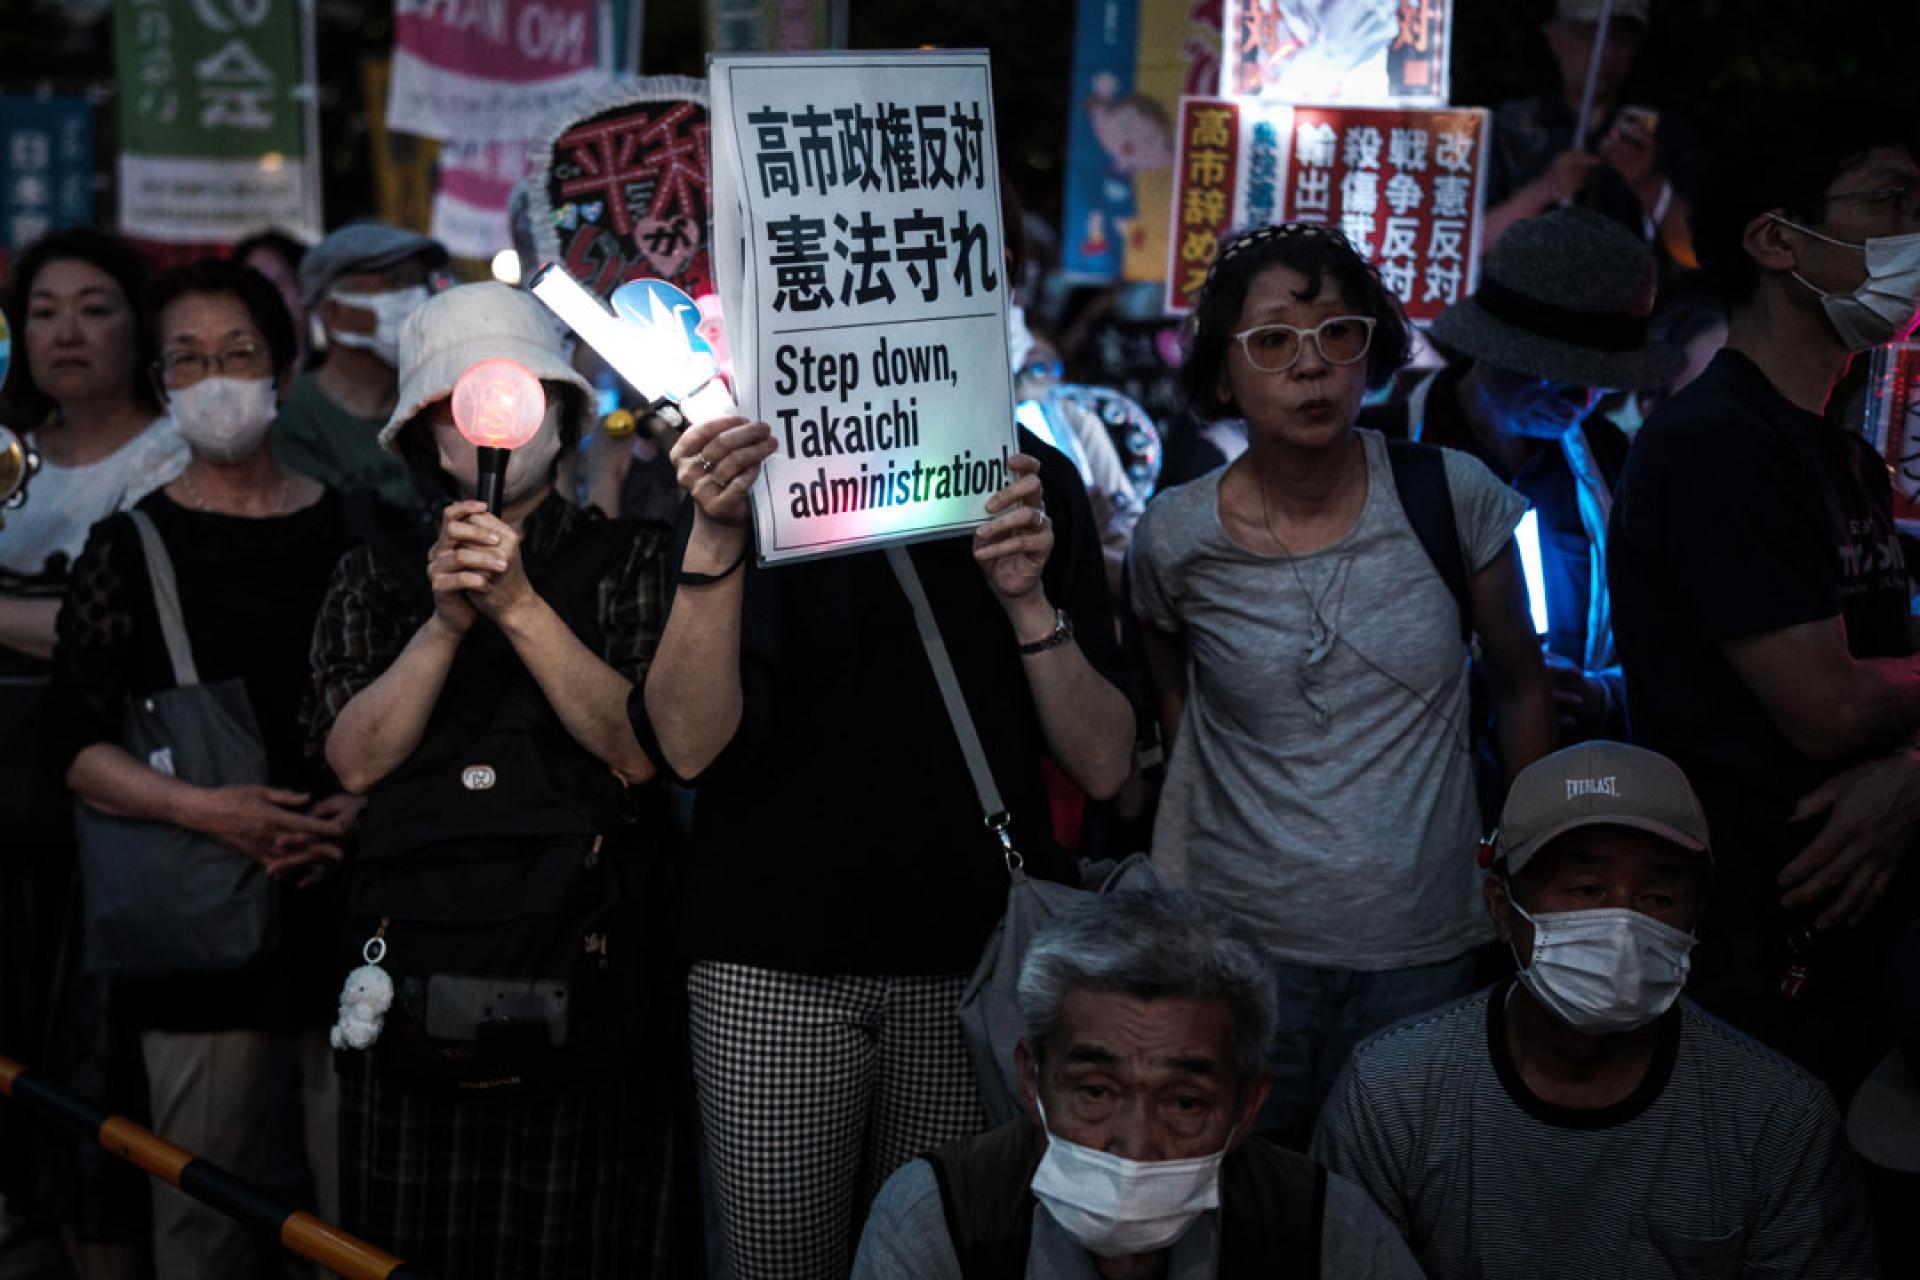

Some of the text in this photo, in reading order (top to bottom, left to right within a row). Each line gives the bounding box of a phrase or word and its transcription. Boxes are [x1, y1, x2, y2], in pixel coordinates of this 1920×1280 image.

[748, 102, 984, 198] 高市政権反対
[1294, 121, 1338, 223] 輸出
[766, 208, 998, 313] 憲法守れ
[1378, 127, 1429, 305] 戦争反対
[1422, 131, 1475, 305] 改憲反対
[775, 336, 958, 403] Step down,
[776, 397, 919, 460] Takaichi
[788, 444, 1010, 519] administration!
[1566, 775, 1617, 800] EVERLAST
